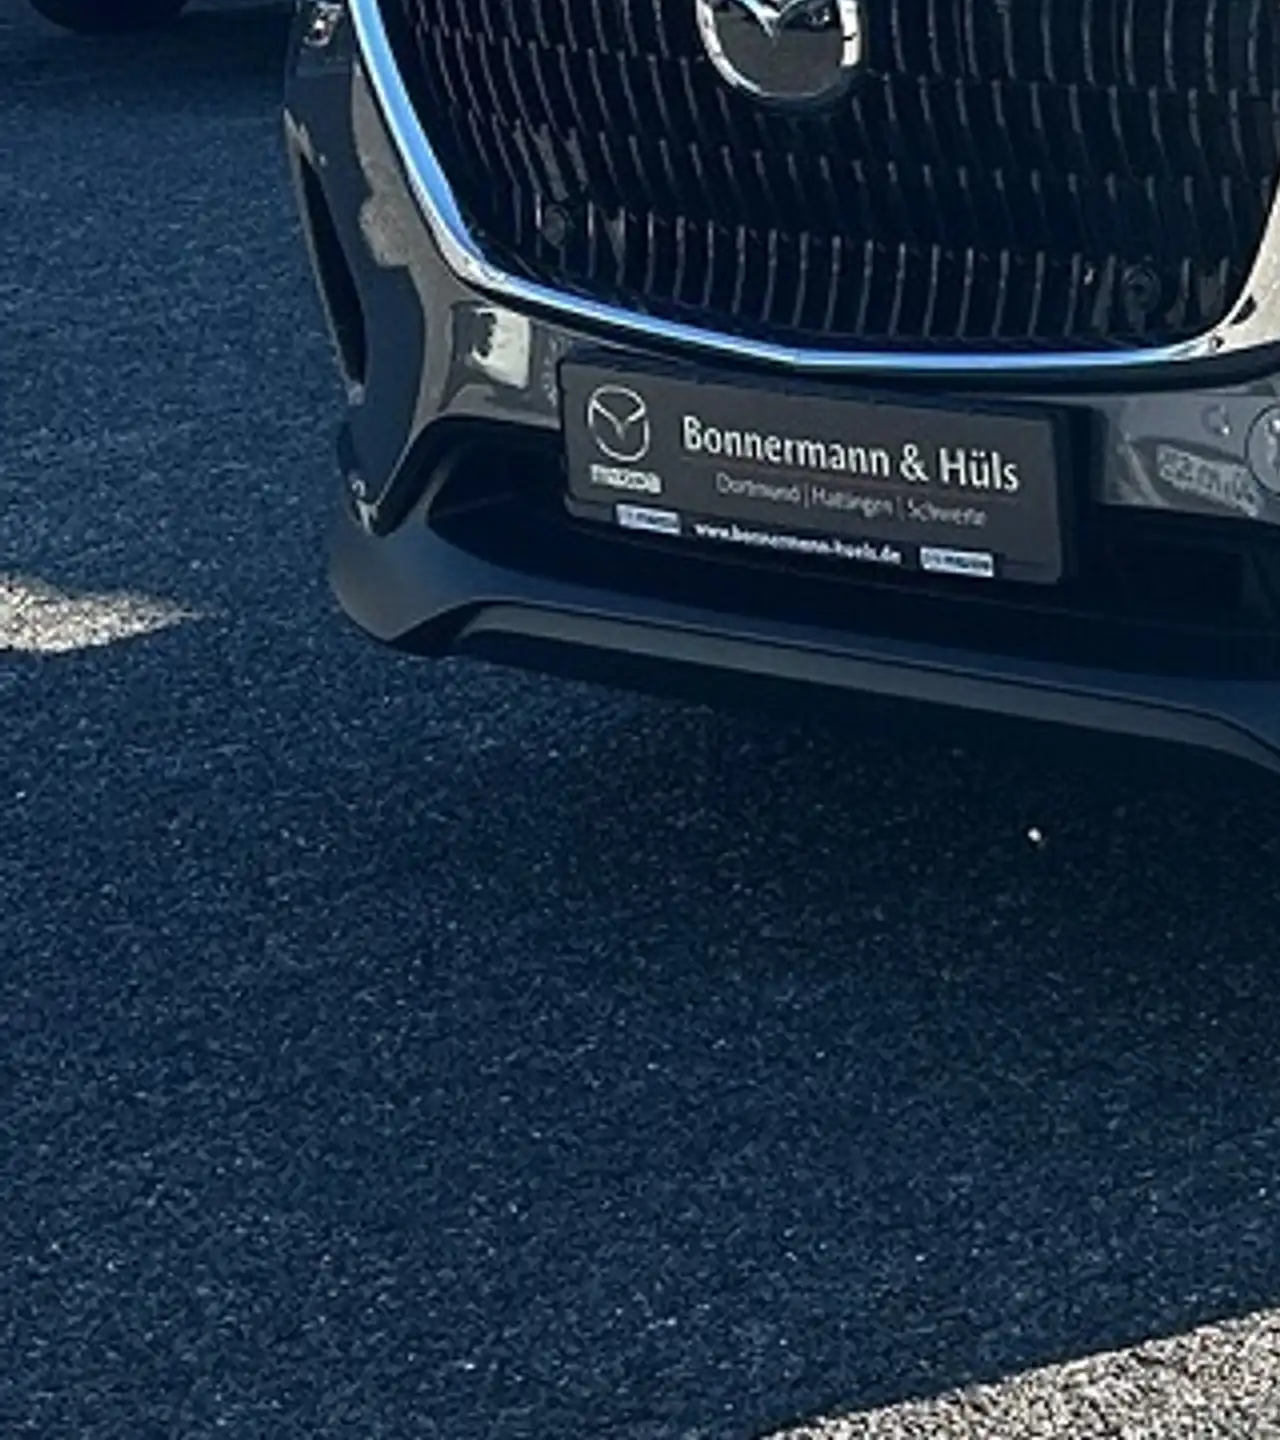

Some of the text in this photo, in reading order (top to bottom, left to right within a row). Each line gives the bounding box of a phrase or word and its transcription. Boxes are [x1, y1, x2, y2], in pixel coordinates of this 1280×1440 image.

[682, 415, 1020, 494] Bonnermann & Hüls
